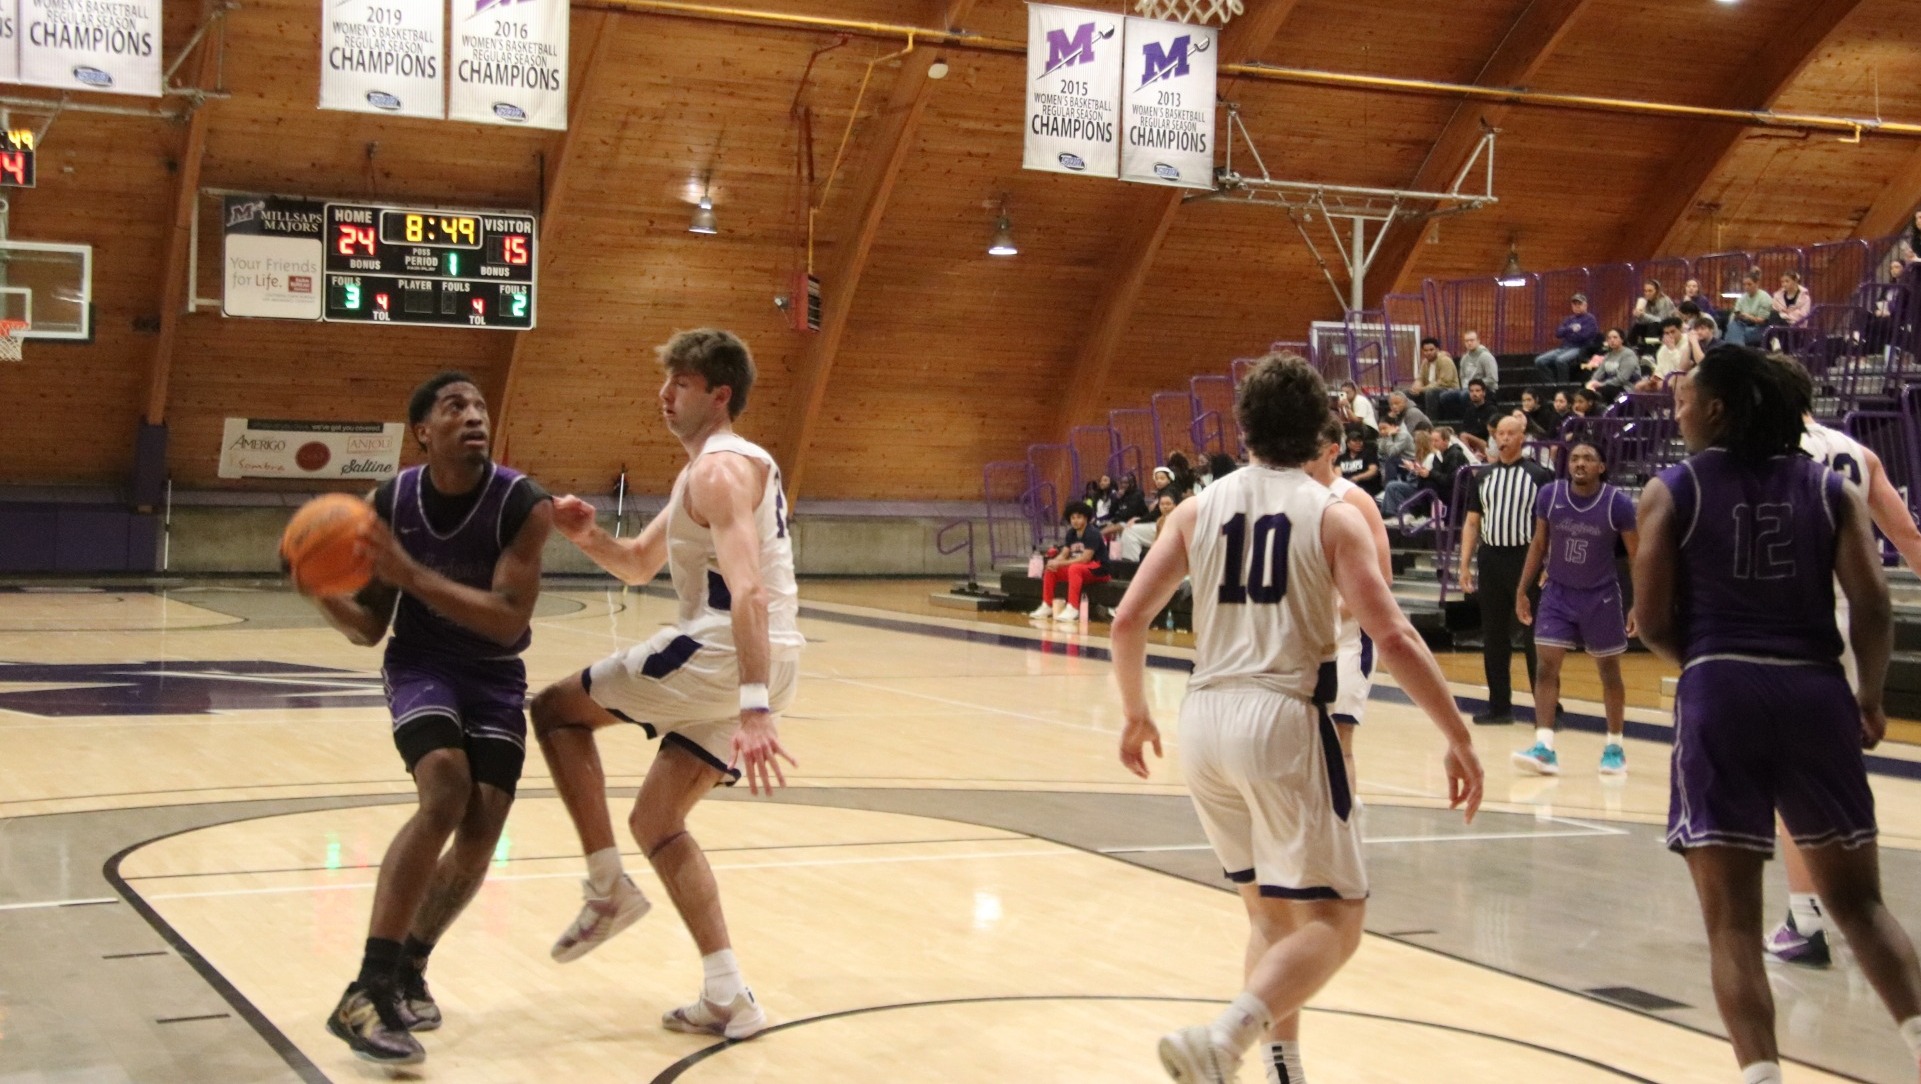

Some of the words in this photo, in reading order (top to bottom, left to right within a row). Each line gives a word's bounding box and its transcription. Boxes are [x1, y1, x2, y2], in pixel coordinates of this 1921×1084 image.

[87, 0, 148, 19] BASKETBALL
[367, 6, 402, 25] 2019
[47, 10, 94, 26] REGULAR
[97, 14, 136, 30] SEASON
[494, 20, 528, 39] 2016
[30, 22, 152, 56] CHAMPIONS
[332, 20, 376, 37] WOMEN'S
[380, 26, 434, 43] BASKETBALL
[344, 36, 386, 51] REGULAR
[388, 40, 423, 54] SEASON
[462, 34, 504, 50] WOMEN'S
[506, 40, 557, 56] BASKETBALL
[1044, 22, 1095, 72] M
[329, 46, 436, 79] CHAMPIONS
[473, 48, 512, 64] REGULAR
[515, 53, 547, 68] SEASON
[1142, 34, 1190, 86] M
[458, 59, 560, 91] CHAMPIONS
[1061, 80, 1088, 96] 2015
[1034, 92, 1068, 106] WOMEN'S
[1070, 96, 1112, 111] BASKETBALL
[1158, 90, 1181, 107] 2013
[1042, 104, 1074, 119] REGULAR
[1077, 108, 1103, 122] SEASON
[1132, 104, 1164, 118] WOMEN'S
[1165, 108, 1205, 123] BASKETBALL
[1032, 114, 1112, 143] CHAMPIONS
[1140, 116, 1170, 130] REGULAR
[1172, 120, 1197, 132] SEASON
[1130, 126, 1206, 153] CHAMPIONS
[0, 151, 24, 184] 4
[261, 210, 323, 224] MILLSAPS
[264, 220, 318, 232] MAJORS
[335, 210, 372, 224] HOME
[485, 219, 531, 233] VISITOR
[406, 214, 475, 245] 8:49
[339, 224, 375, 256] 24
[504, 236, 527, 264] 15
[230, 257, 260, 270] Your
[266, 258, 317, 273] Friends
[350, 259, 381, 270] BONUS
[405, 256, 438, 266] PERIOD
[450, 252, 458, 276] 1
[232, 272, 252, 288] for
[332, 276, 361, 286] FOULS
[480, 267, 510, 277] BONUS
[398, 280, 432, 290] PLAYER
[442, 282, 470, 292] FOULS
[500, 285, 527, 295] FOULS
[345, 286, 360, 309] 3
[376, 293, 388, 310] 4
[472, 298, 484, 314] 4
[512, 294, 527, 316] 2
[373, 311, 390, 321] TOL
[469, 316, 486, 325] TOL
[341, 459, 392, 475] Saltine
[1565, 538, 1588, 564] 15
[1733, 503, 1796, 580] 12
[1218, 512, 1292, 604] 10
